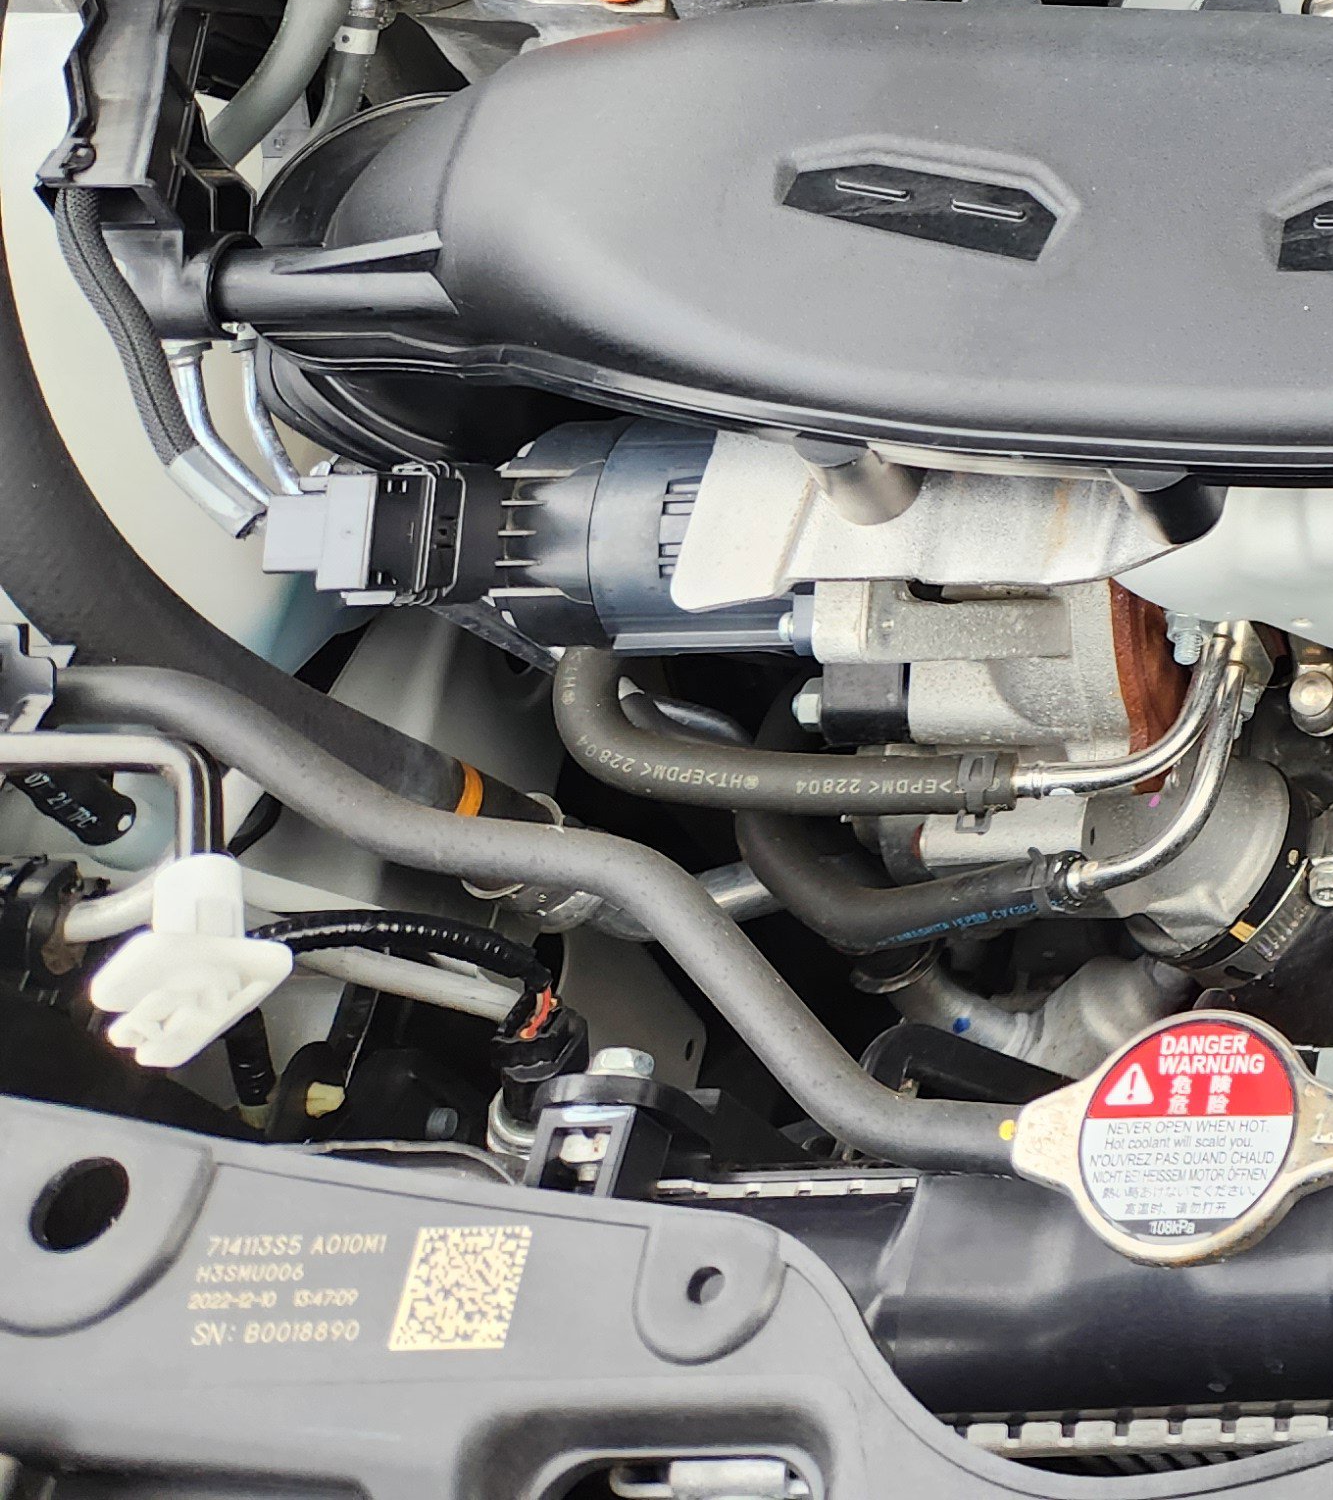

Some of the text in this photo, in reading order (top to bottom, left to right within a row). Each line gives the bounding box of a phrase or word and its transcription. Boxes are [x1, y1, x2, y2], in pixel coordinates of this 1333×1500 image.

[575, 734, 636, 774] 22804
[796, 776, 861, 793] 22804
[1160, 1033, 1249, 1056] DANGER
[1158, 1053, 1266, 1076] WARNUNG
[1107, 1121, 1151, 1134] NEVER
[1156, 1120, 1192, 1134] OPEN
[1197, 1120, 1235, 1133] WHEN
[1104, 1136, 1254, 1151] Hot coolant will scald you.
[1090, 1152, 1152, 1167] N'OUVREZ
[1155, 1152, 1179, 1166] PAS
[1183, 1151, 1228, 1165] QUAND
[1092, 1171, 1122, 1183] NICHT
[1124, 1170, 1141, 1183] BEI
[1143, 1169, 1187, 1182] HEISSEM
[1188, 1168, 1224, 1182] MOTOR
[1149, 1220, 1196, 1235] 108kPa
[187, 1289, 278, 1310] 2022-12-10
[191, 1318, 361, 1347] SN: B0018890
